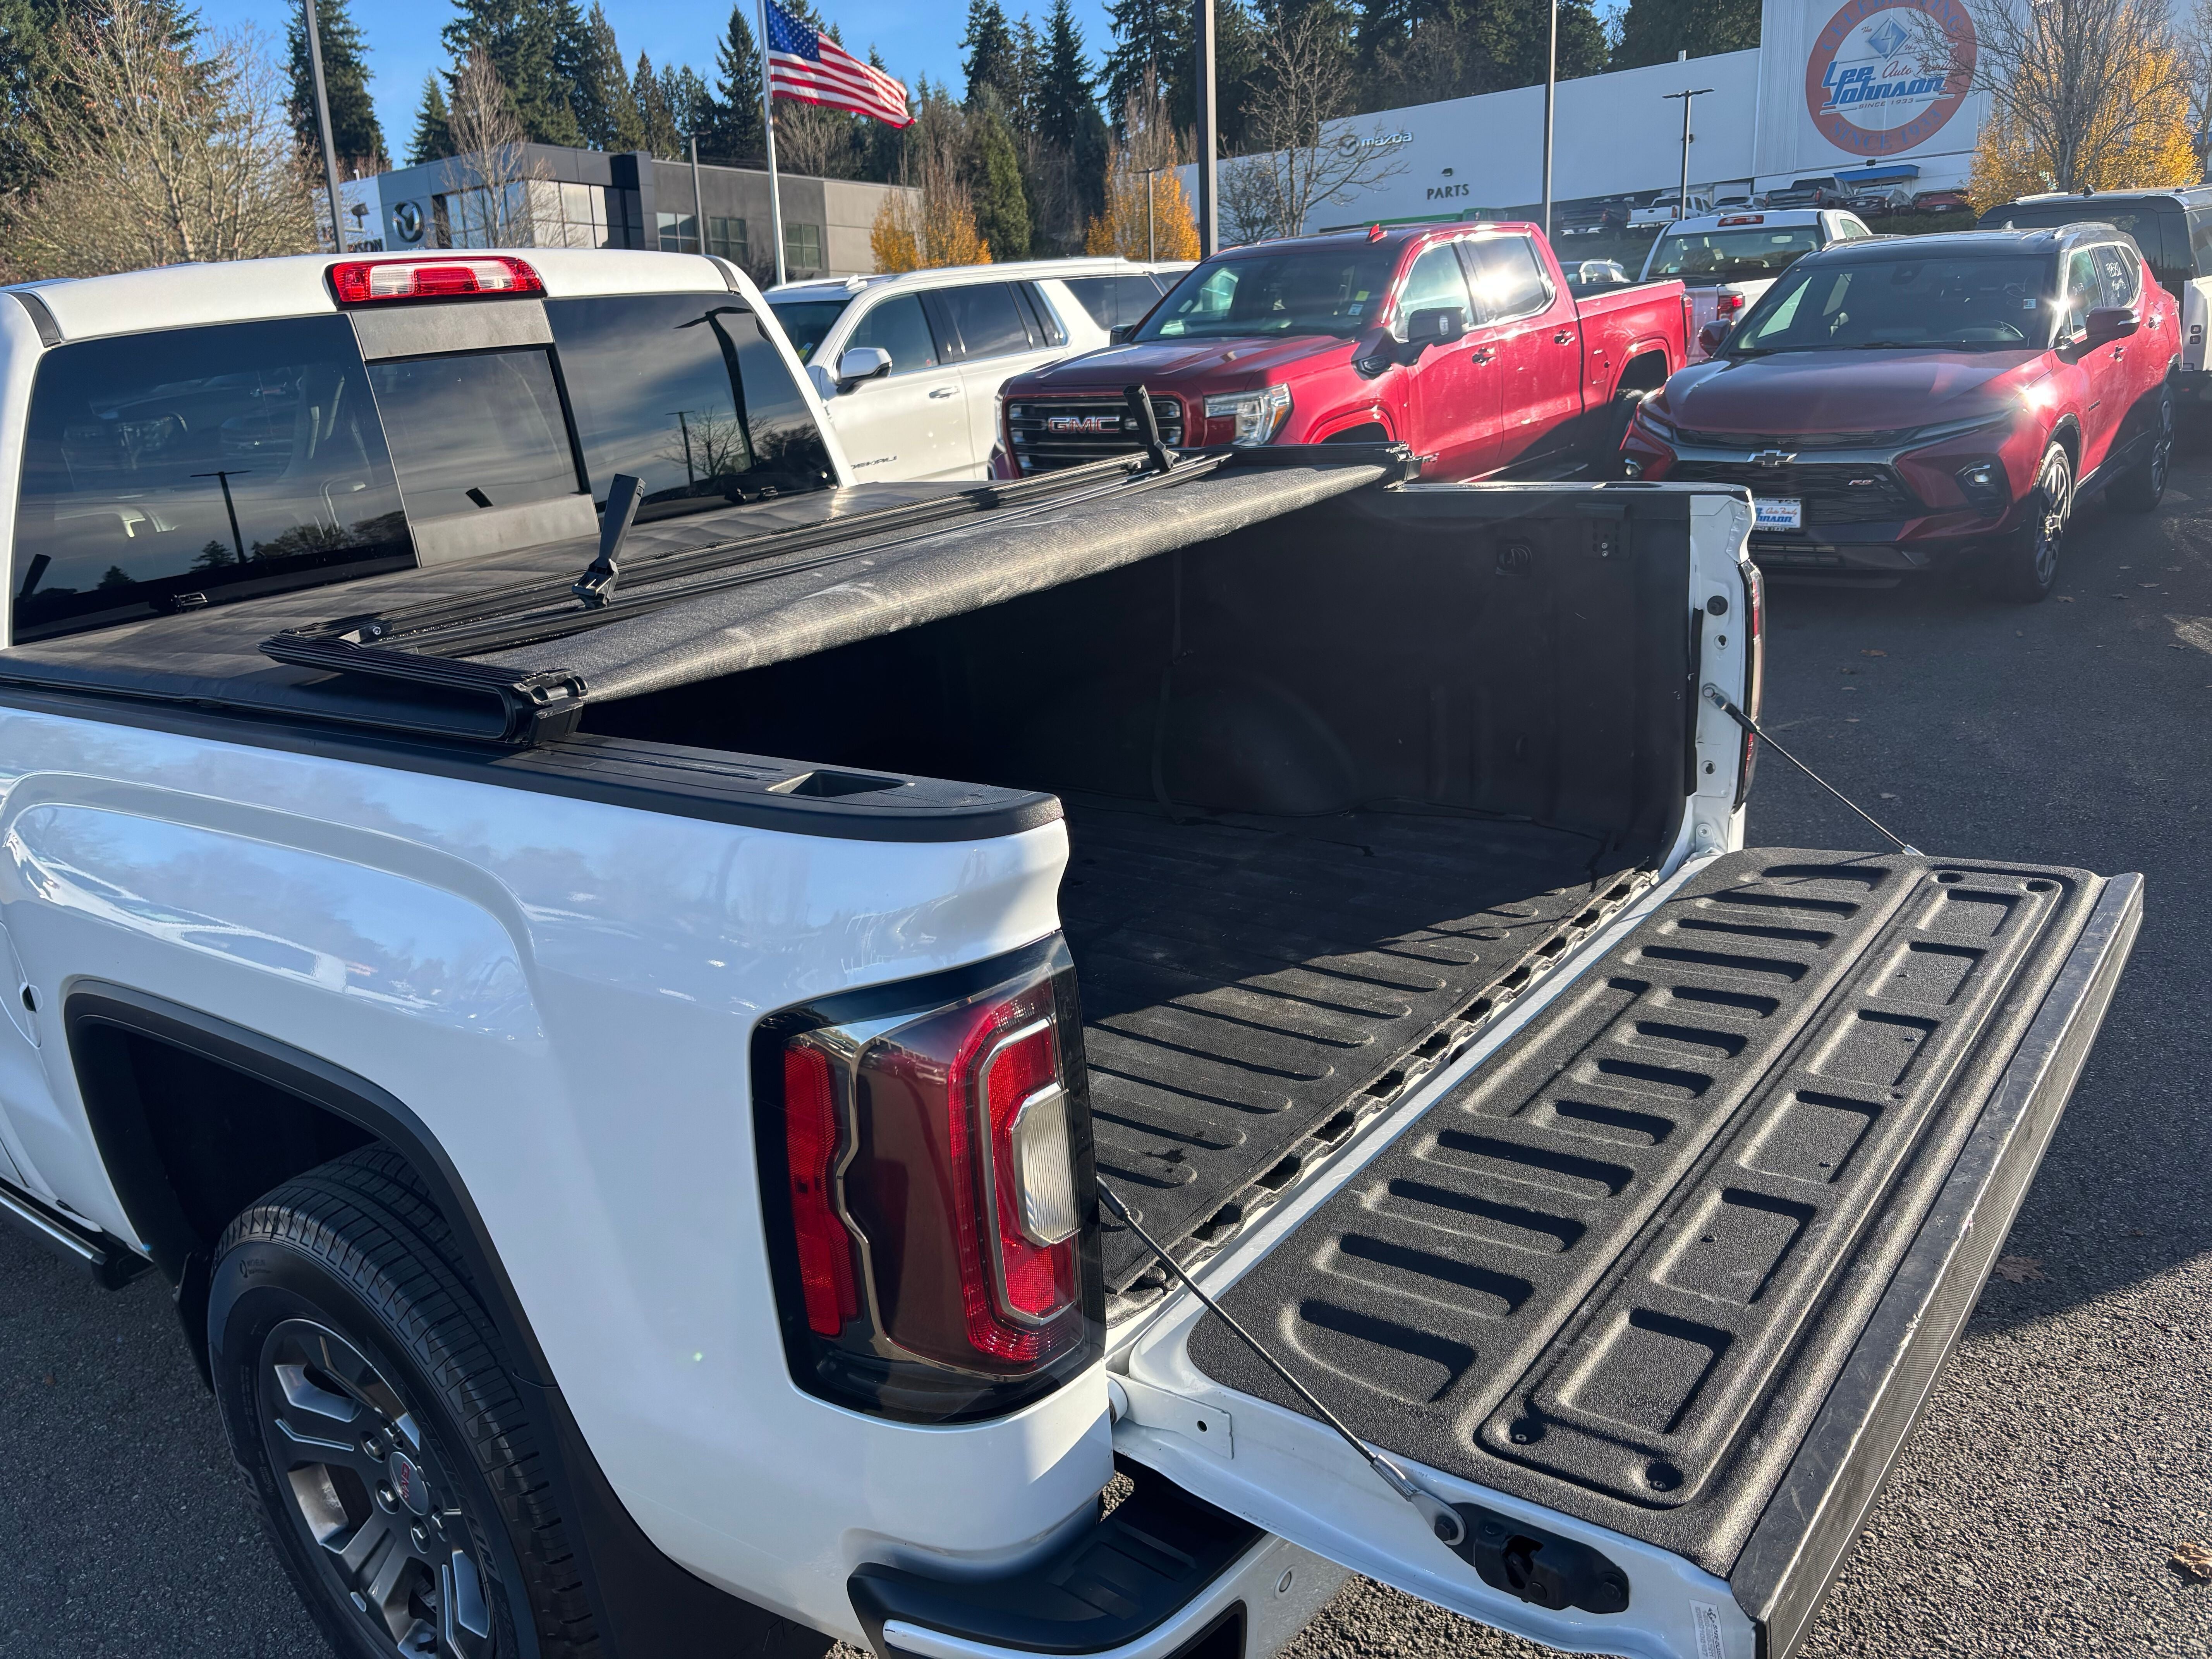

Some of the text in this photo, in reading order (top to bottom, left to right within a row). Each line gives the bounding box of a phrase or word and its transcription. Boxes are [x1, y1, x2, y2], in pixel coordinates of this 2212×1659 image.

[1822, 62, 1874, 88] Lee
[1882, 61, 1913, 79] Auto
[1823, 76, 1947, 106] Johnson
[1361, 132, 1413, 147] mazda
[1832, 109, 1942, 150] SINCE 1933
[1427, 184, 1470, 200] PARTS
[1048, 416, 1120, 433] GMC
